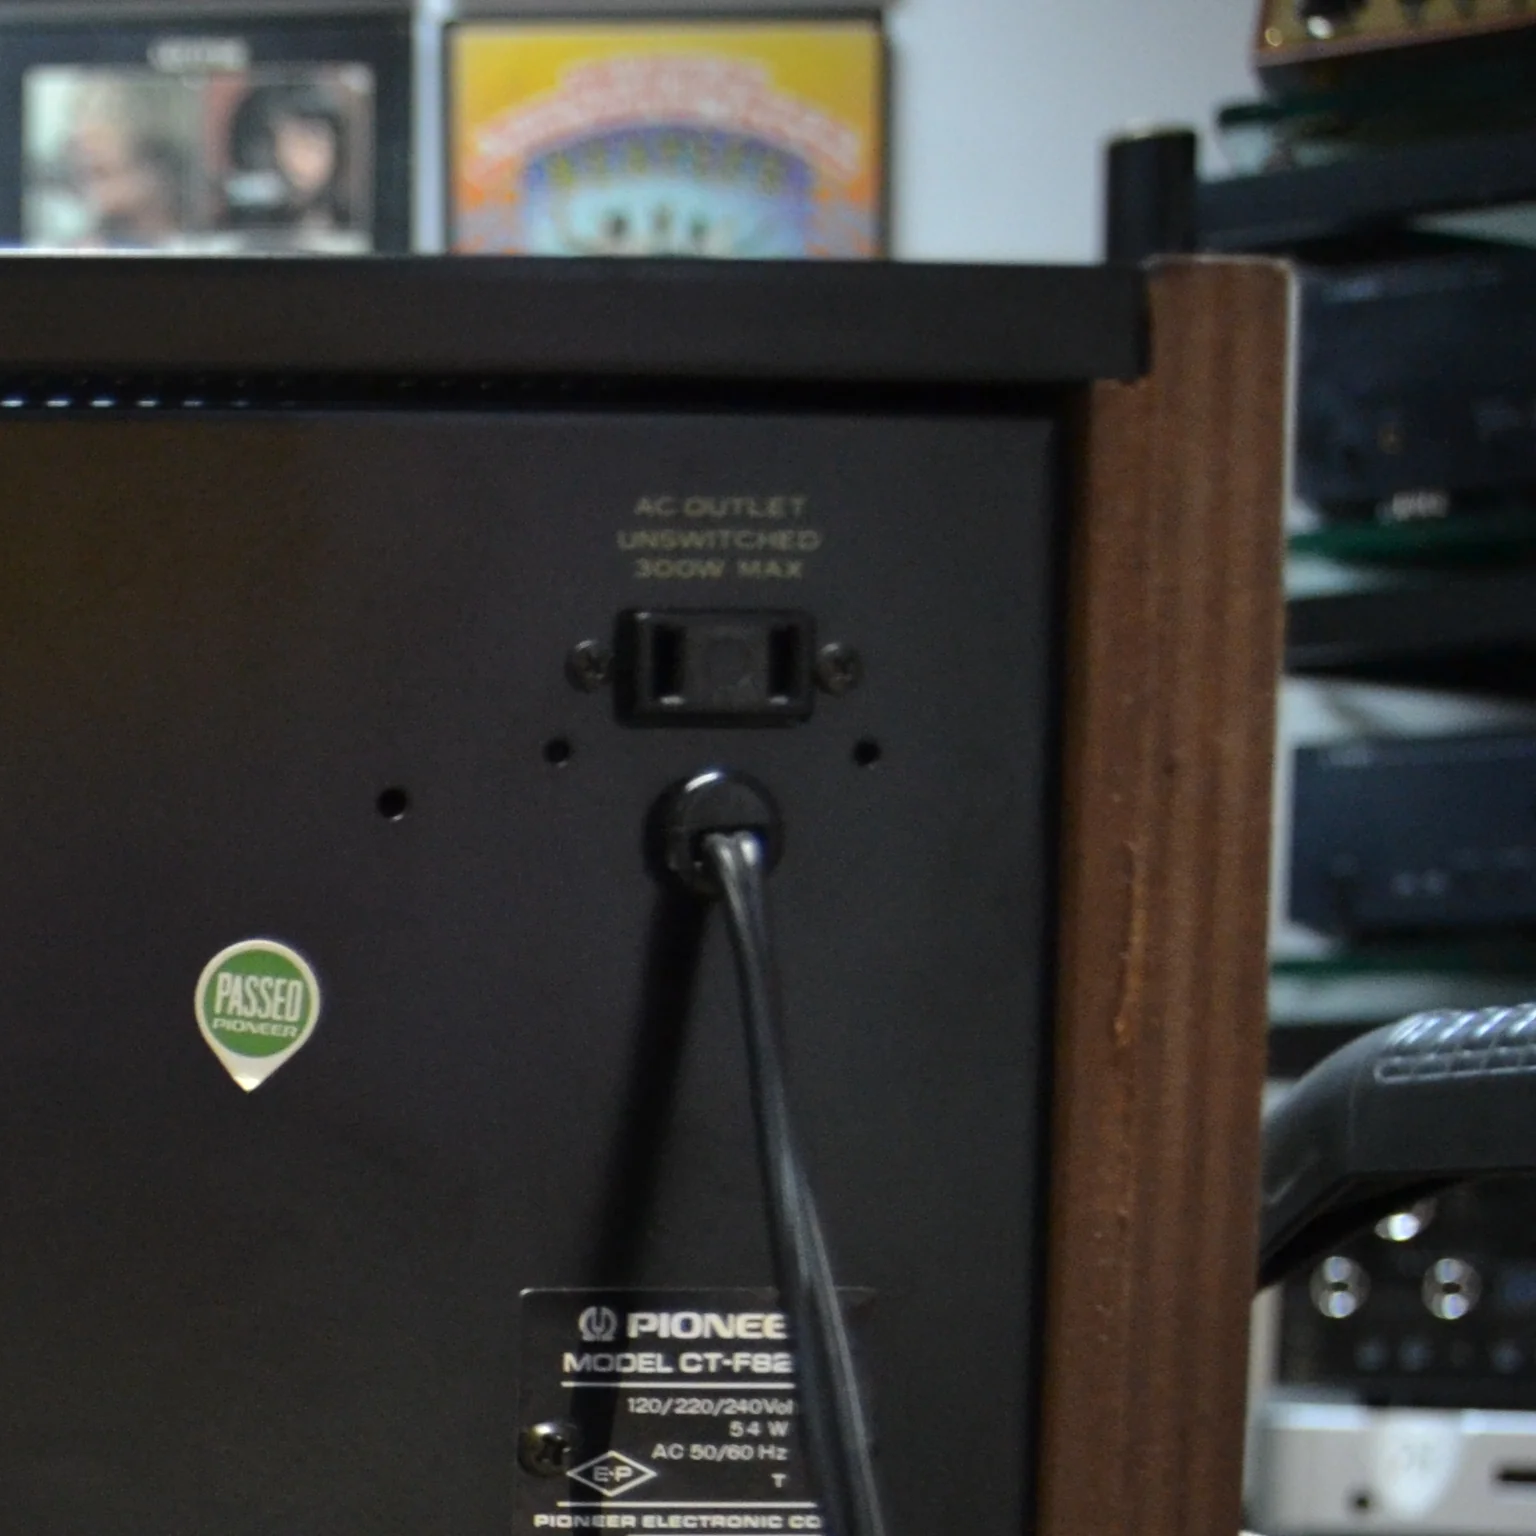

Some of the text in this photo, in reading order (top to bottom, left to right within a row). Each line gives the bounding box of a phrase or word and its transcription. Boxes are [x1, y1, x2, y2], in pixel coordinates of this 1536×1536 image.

[634, 496, 808, 518] AC OUTLET
[616, 529, 824, 551] UNSWITCHED
[633, 557, 804, 580] 300W MAX
[214, 971, 305, 1022] PASSED
[212, 1017, 298, 1037] PIONEER
[626, 1312, 790, 1339] PIONEE
[561, 1352, 794, 1374] MODEL CT-F82
[626, 1397, 794, 1416] 120/220/240Vol
[650, 1443, 789, 1462] AC 50/60 Hz
[533, 1514, 637, 1529] PIONEER
[641, 1514, 784, 1530] ELECTRONIC
